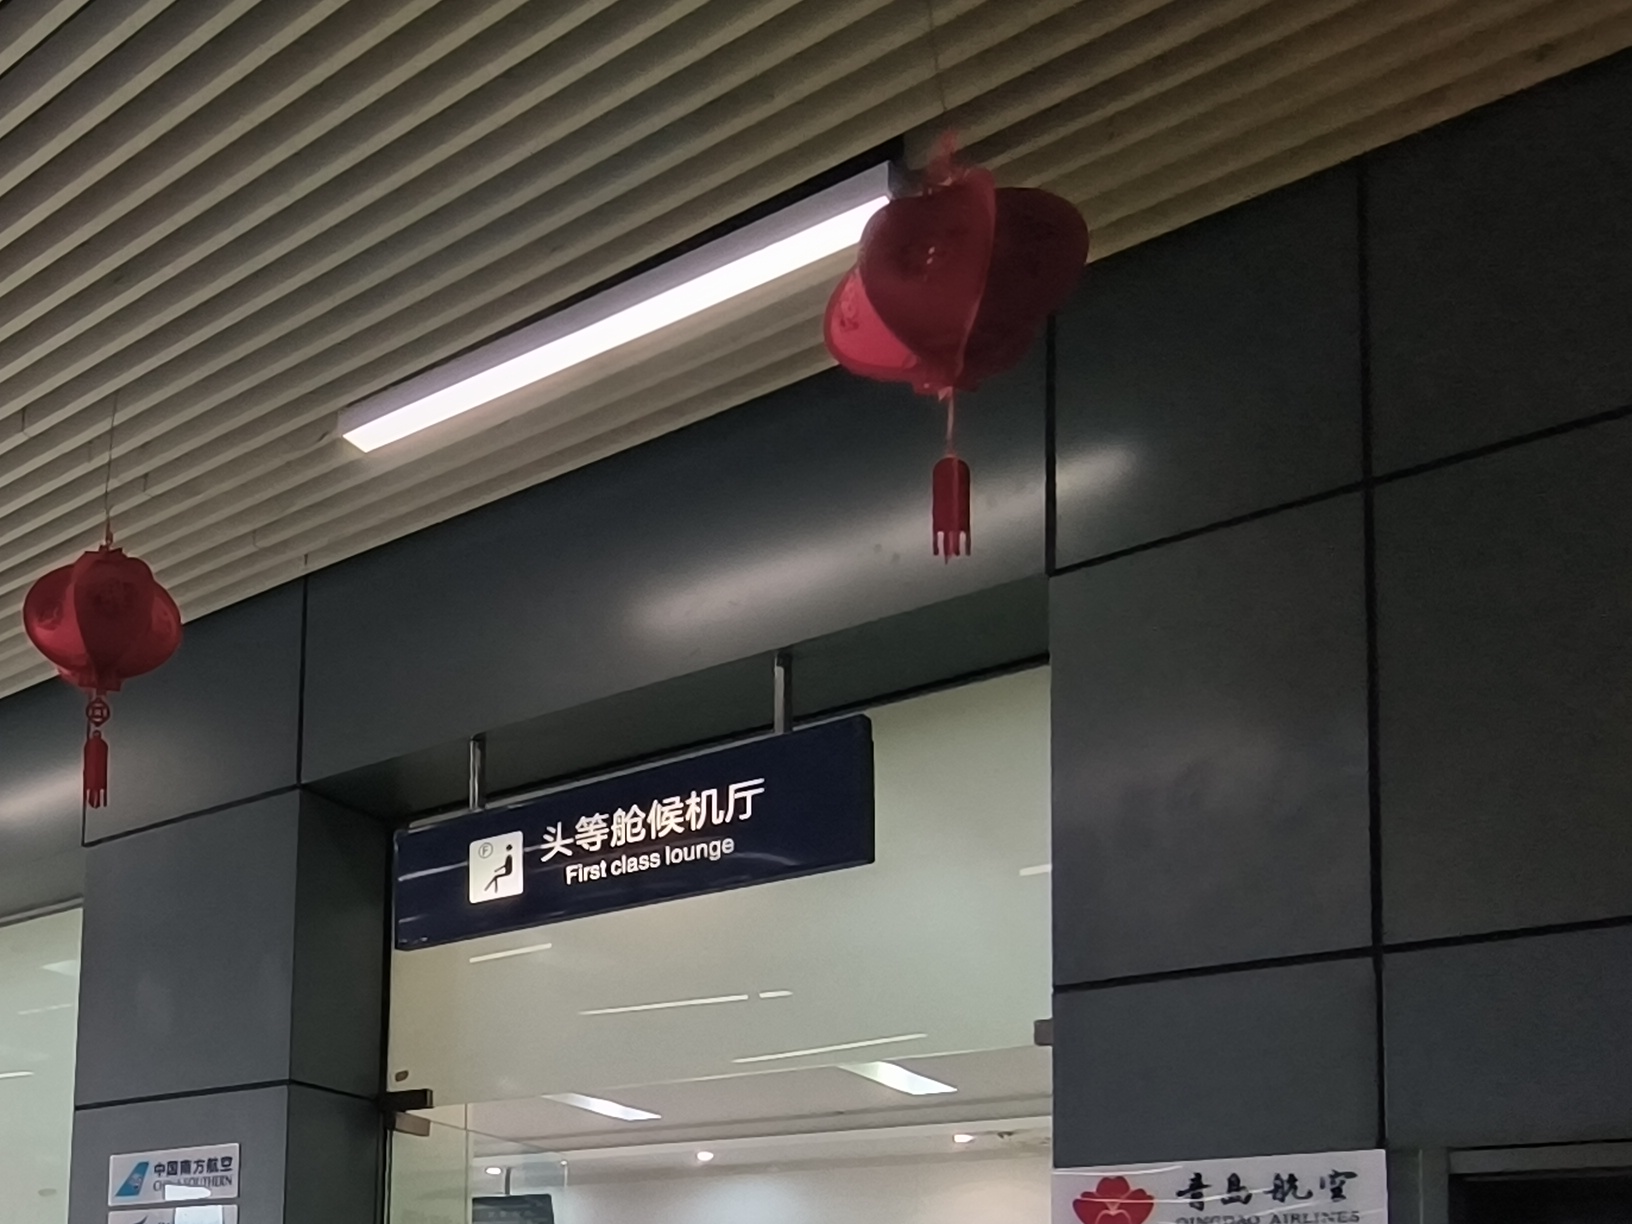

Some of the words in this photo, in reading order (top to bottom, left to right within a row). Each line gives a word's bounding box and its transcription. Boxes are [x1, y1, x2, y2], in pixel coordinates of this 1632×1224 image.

[540, 777, 765, 862] 头等舱候机厅
[565, 859, 607, 885] First
[611, 850, 661, 876] class
[665, 837, 735, 867] lounge
[153, 1156, 233, 1178] 中国南方航空
[1176, 1169, 1358, 1212] 青岛航空
